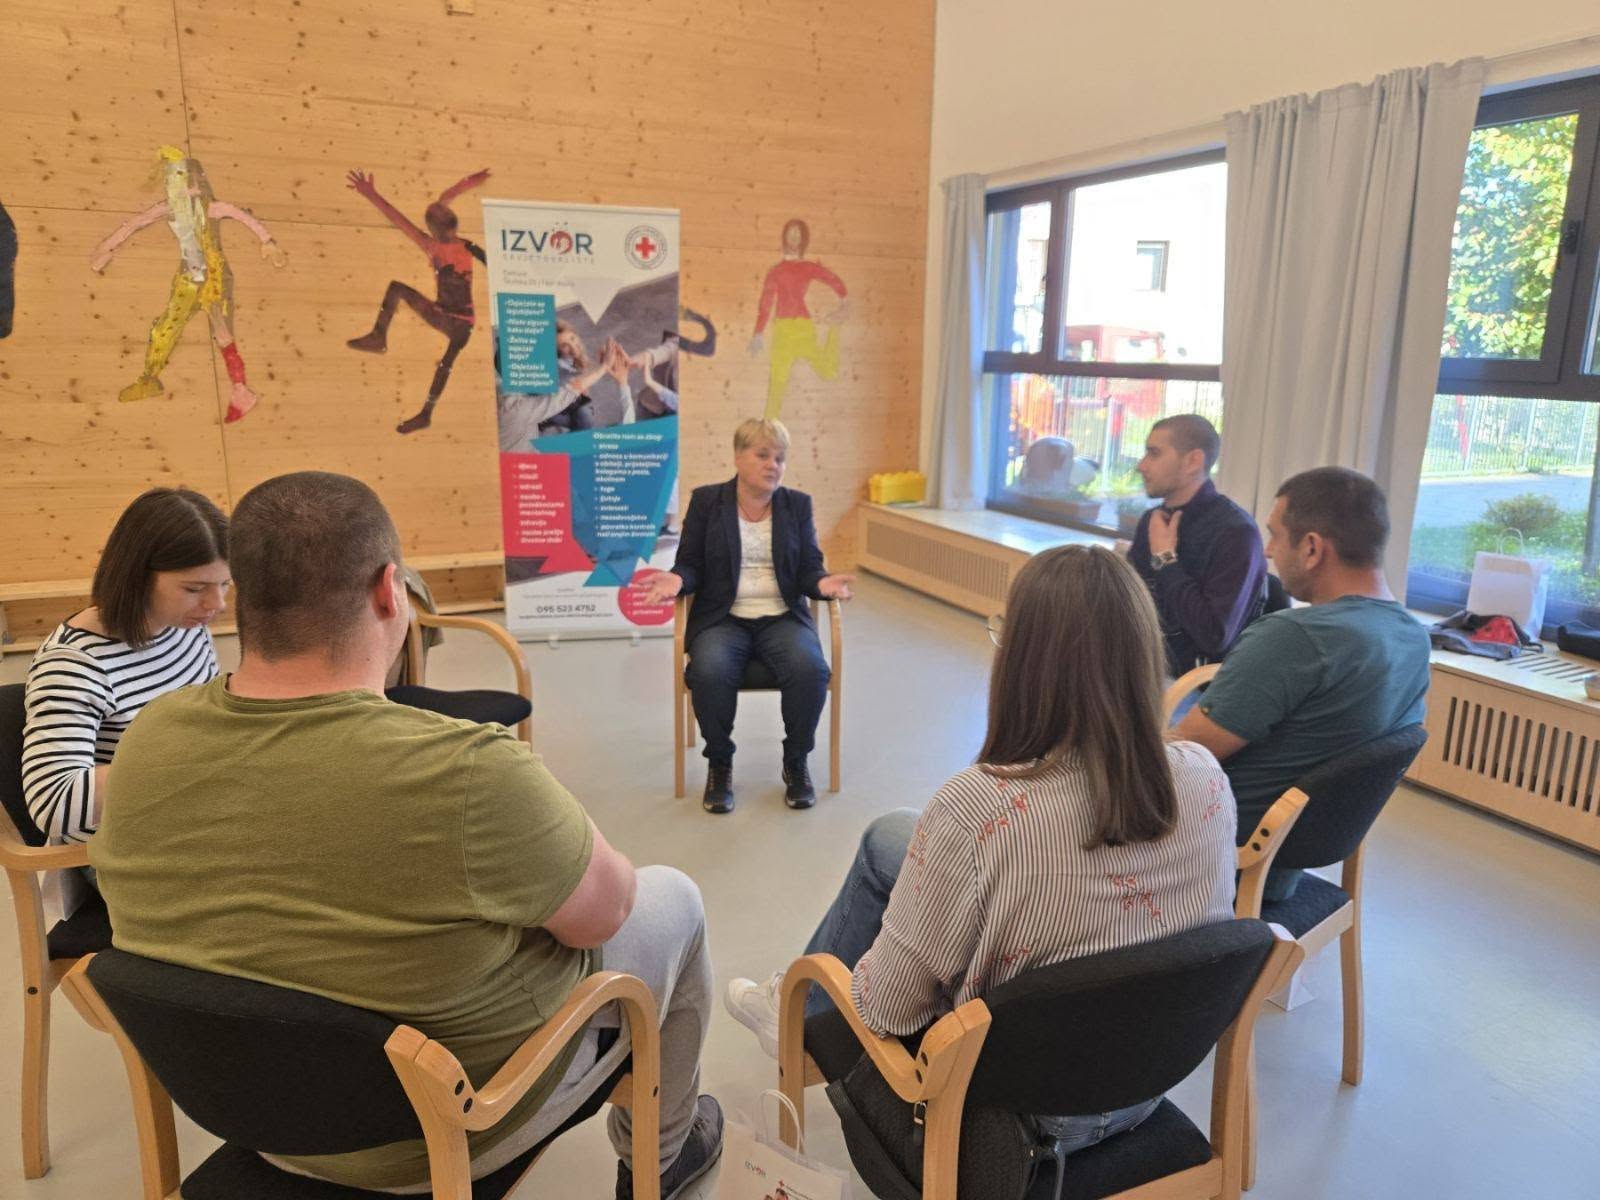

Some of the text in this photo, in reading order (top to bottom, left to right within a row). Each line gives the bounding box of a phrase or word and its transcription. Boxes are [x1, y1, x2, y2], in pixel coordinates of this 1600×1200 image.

[501, 228, 593, 256] IZVOR
[536, 604, 596, 613] 095 523 4752
